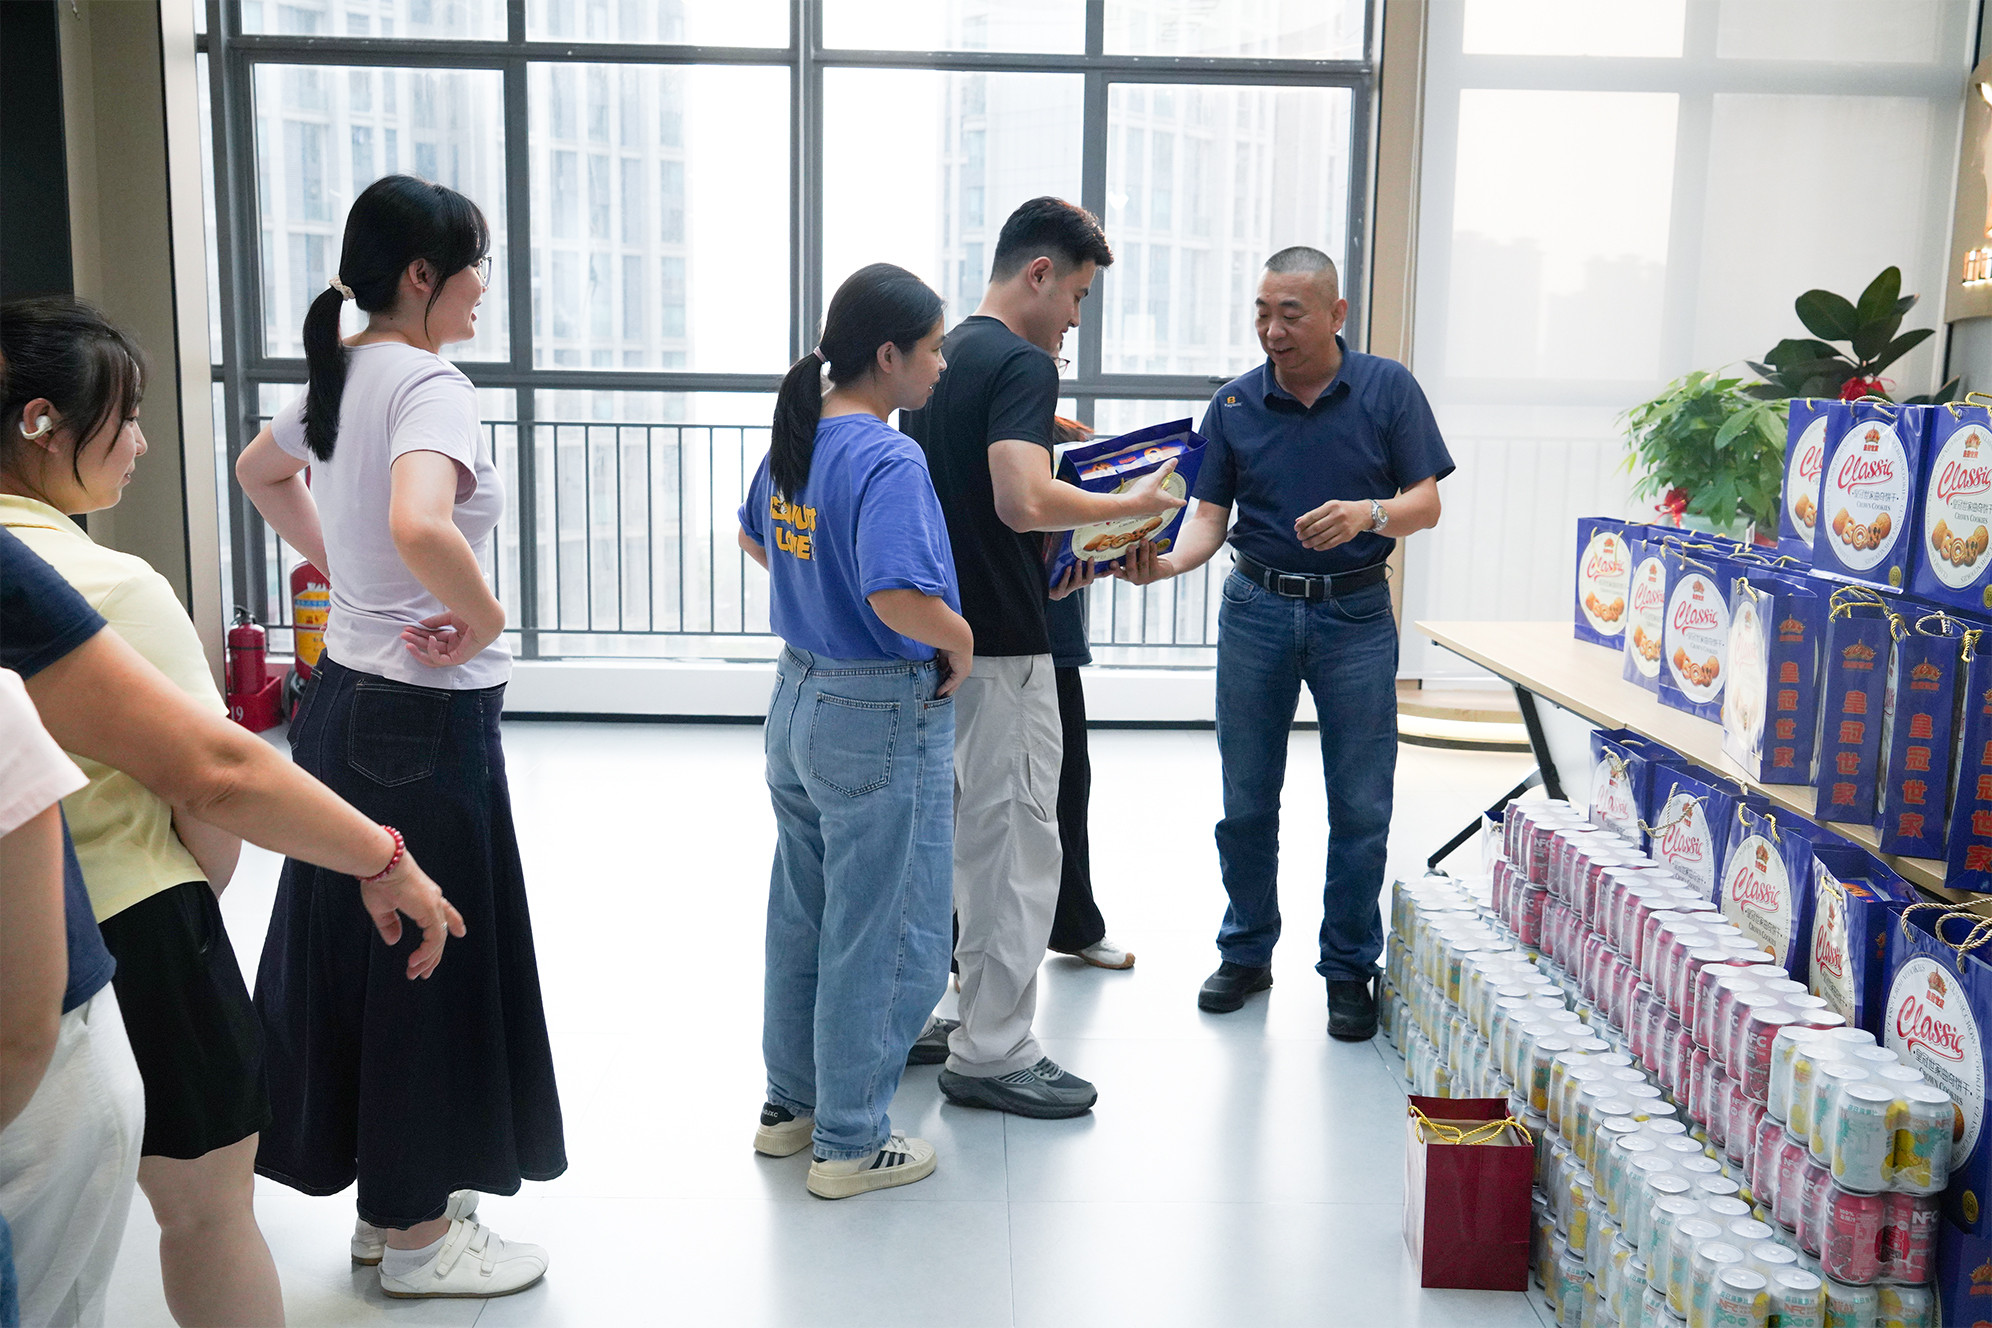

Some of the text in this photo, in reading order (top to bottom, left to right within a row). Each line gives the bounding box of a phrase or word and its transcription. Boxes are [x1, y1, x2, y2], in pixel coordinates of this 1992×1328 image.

[1838, 454, 1894, 495] Classic
[1937, 460, 1992, 506] Classic
[1674, 601, 1719, 636] Classic
[1773, 661, 1799, 768] 皇冠世家
[1832, 690, 1867, 806] 皇冠世家
[1897, 713, 1933, 838] 皇冠世家
[1662, 823, 1703, 864] Classic
[1733, 866, 1780, 913] Classic
[1816, 925, 1843, 979] Classic
[1897, 995, 1965, 1063] Classic
[1912, 1209, 1939, 1225] NFC
